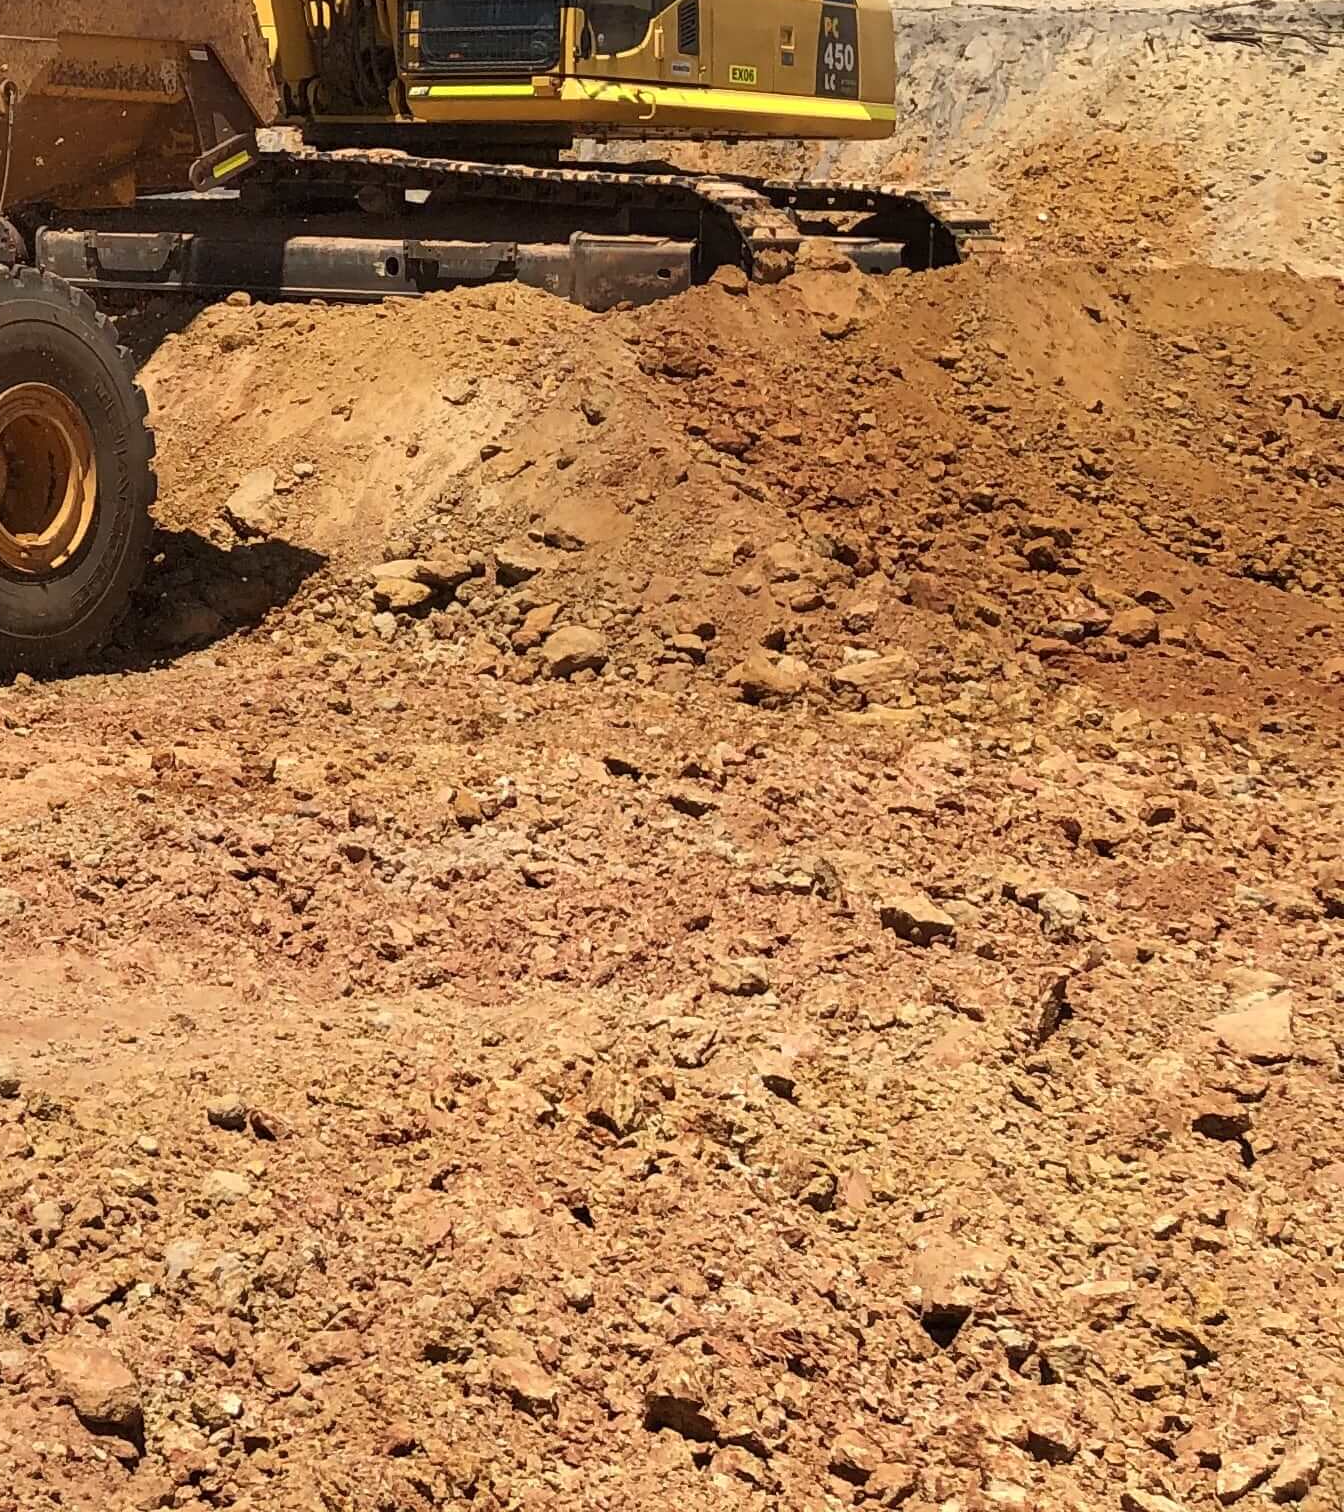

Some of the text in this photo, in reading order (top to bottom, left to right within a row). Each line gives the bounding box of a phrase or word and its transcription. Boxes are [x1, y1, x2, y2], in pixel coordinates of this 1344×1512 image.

[823, 16, 840, 39] PC
[823, 41, 855, 73] 450
[731, 66, 755, 83] EX06
[824, 72, 837, 91] LC
